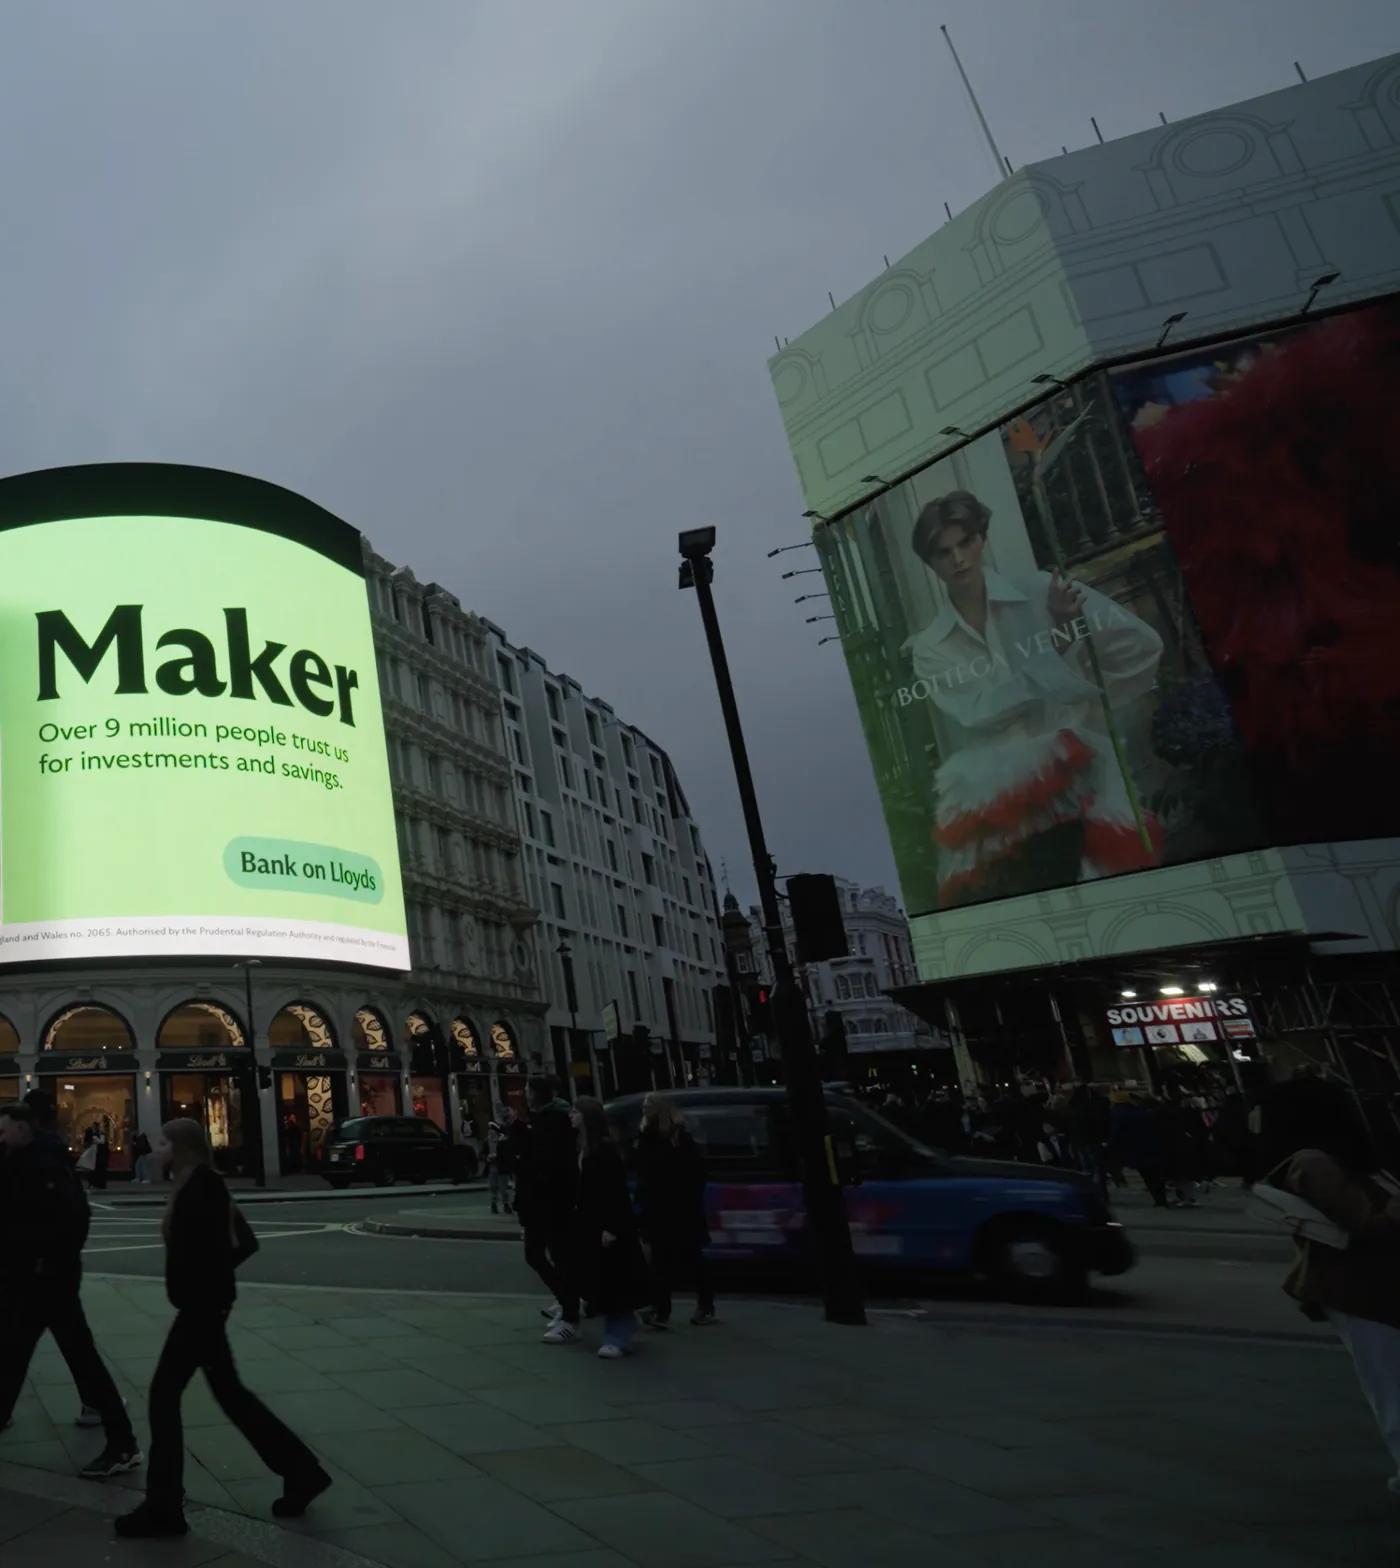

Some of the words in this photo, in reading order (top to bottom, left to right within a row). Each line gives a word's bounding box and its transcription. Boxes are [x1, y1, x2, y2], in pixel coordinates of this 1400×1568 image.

[35, 604, 359, 728] Maker
[896, 652, 1009, 708] BOTTEGA
[1014, 604, 1129, 660] VENETA
[39, 722, 97, 743] Over
[105, 718, 120, 738] 9
[130, 717, 207, 737] million
[216, 725, 286, 747] people
[292, 732, 330, 757] trust
[335, 745, 349, 763] us
[39, 753, 72, 774] for
[81, 751, 229, 770] investments
[236, 755, 275, 774] and
[282, 763, 343, 790] savings.
[240, 851, 298, 876] Bank
[302, 862, 326, 880] on
[330, 861, 376, 892] Lloyds
[22, 931, 39, 941] and
[40, 930, 68, 940] Wales
[70, 931, 84, 939] no.
[87, 927, 113, 938] 2065.
[116, 926, 166, 936] Authorised
[169, 926, 180, 937] by
[182, 926, 197, 935] the
[200, 926, 244, 936] Prudential
[246, 928, 287, 938] Regulation
[289, 930, 321, 941] Authority
[1106, 997, 1249, 1026] SOUVENIRS
